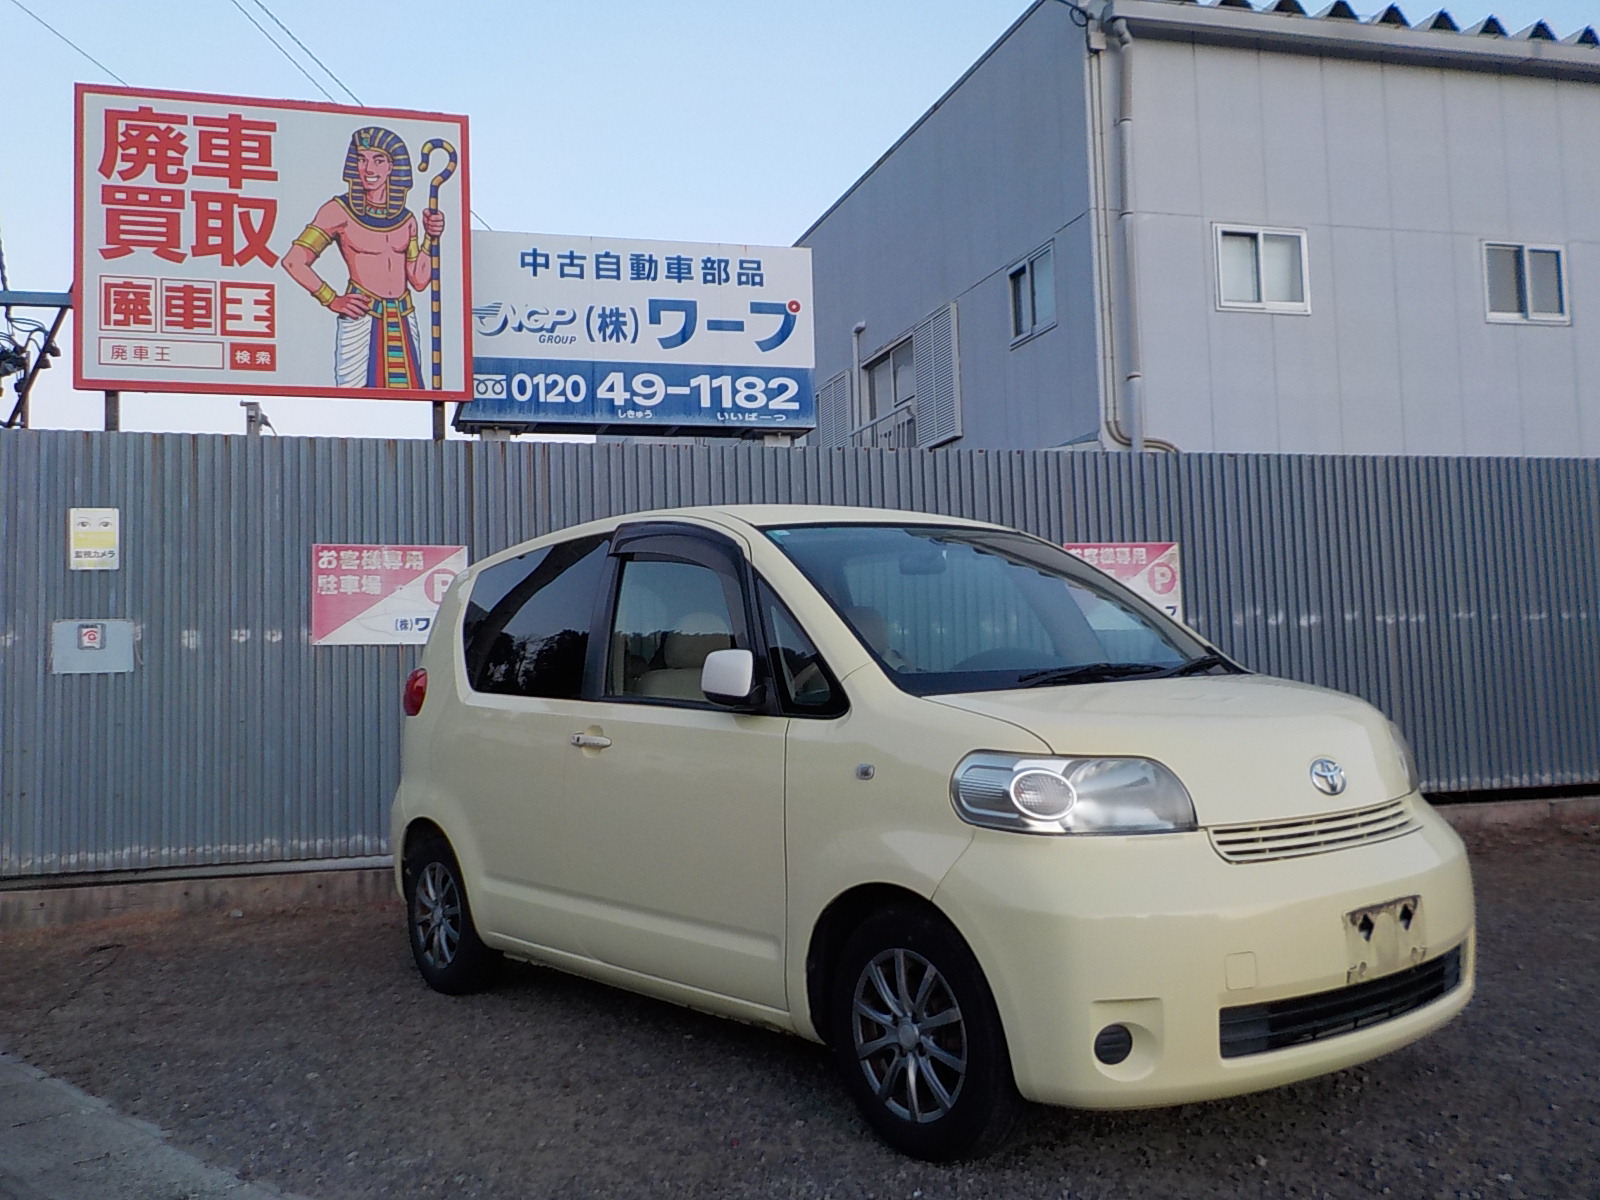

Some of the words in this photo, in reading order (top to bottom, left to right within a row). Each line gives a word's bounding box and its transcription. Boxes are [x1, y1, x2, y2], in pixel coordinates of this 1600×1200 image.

[98, 106, 279, 189] 廃車
[97, 184, 280, 269] 買取
[520, 247, 764, 287] 中古自動車部品
[101, 276, 276, 338] 廃車王
[586, 298, 801, 353] (株)ワープ
[538, 334, 577, 345] GROUP
[110, 344, 171, 362] 廃車王
[235, 349, 271, 366] 検索
[511, 373, 587, 403] 0120
[596, 371, 800, 411] 49-1182
[618, 409, 653, 419] しきゅう
[318, 550, 424, 570] お客様専用
[317, 574, 382, 595] 駐車場
[395, 617, 431, 632] (株)ワ
